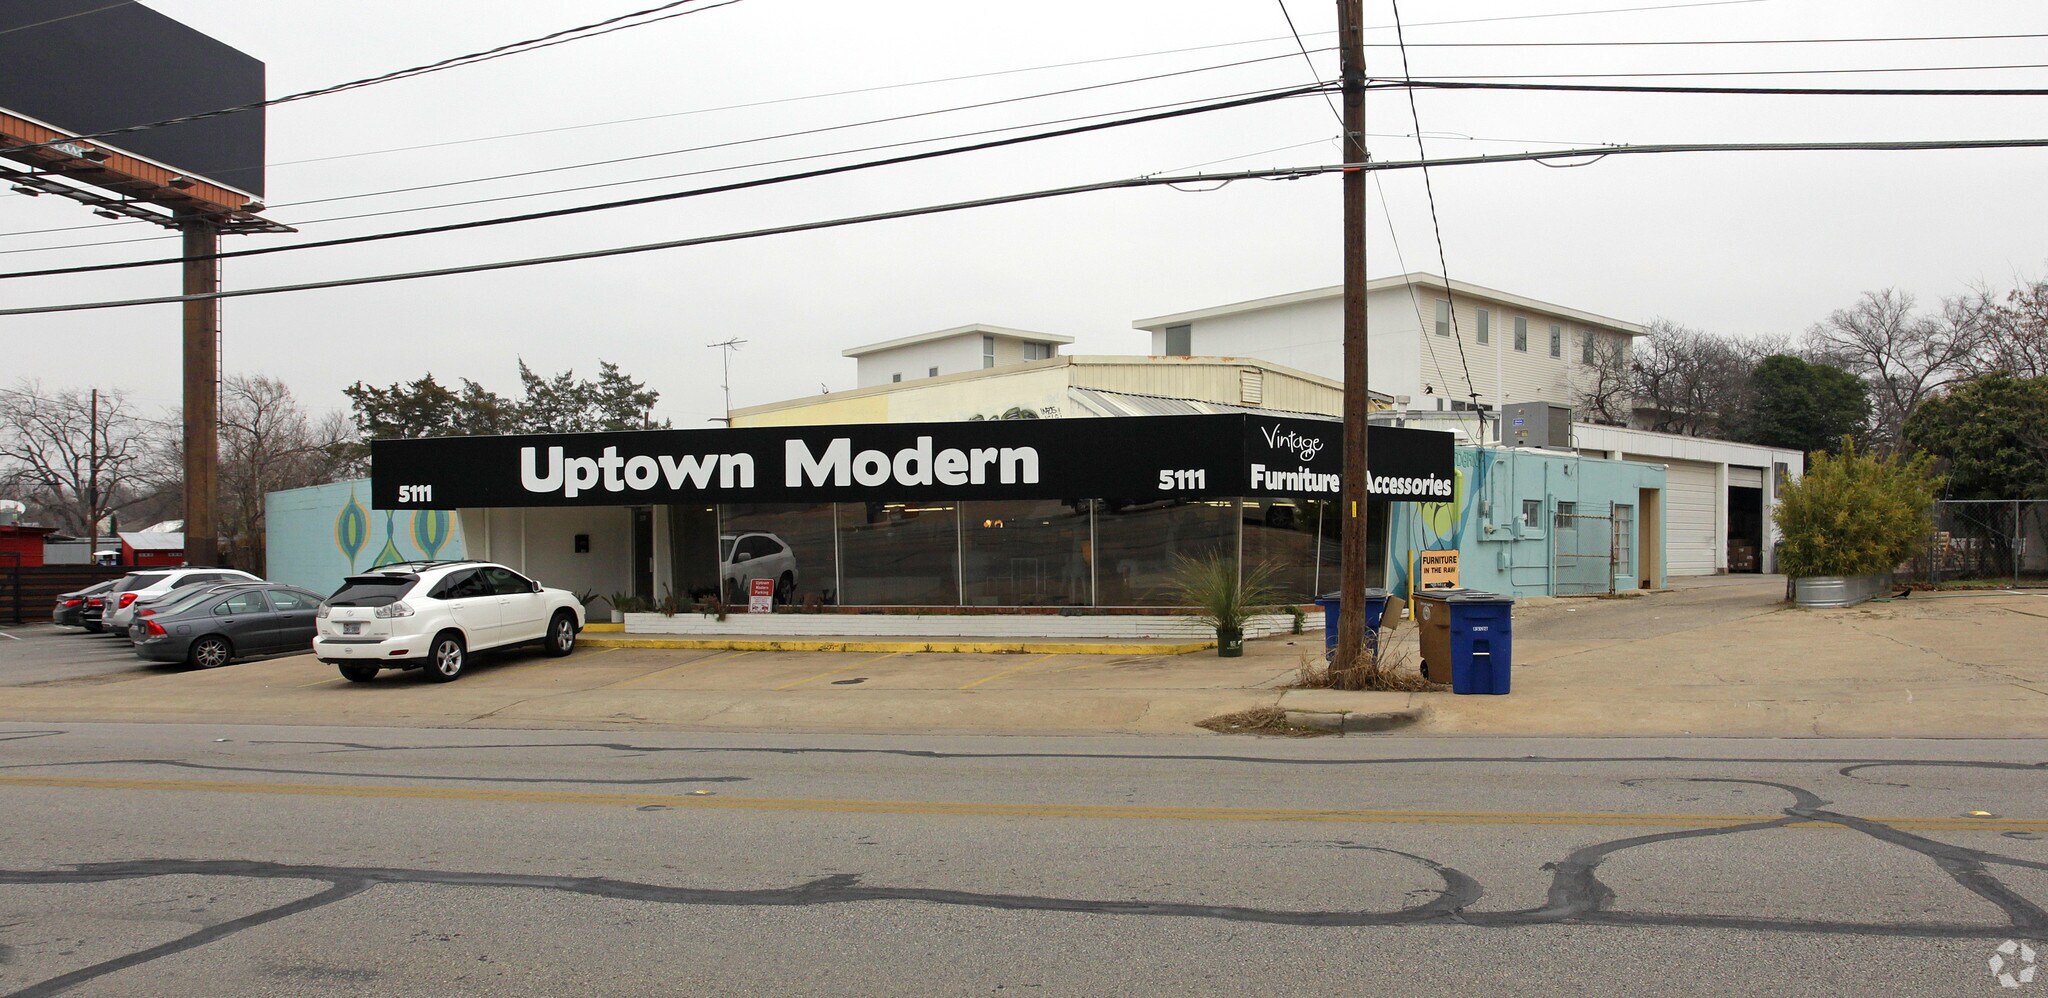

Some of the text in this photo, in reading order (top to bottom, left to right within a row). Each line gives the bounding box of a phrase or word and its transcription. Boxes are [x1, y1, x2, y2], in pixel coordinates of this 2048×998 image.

[1260, 423, 1324, 462] Vintage
[520, 435, 1040, 498] Uptown Modern
[1250, 463, 1340, 493] Furniture
[1158, 468, 1206, 491] 5111
[398, 484, 432, 503] 5111
[1423, 556, 1457, 564] FURNITURE
[1431, 566, 1442, 574] THE
[1443, 566, 1456, 574] RAW
